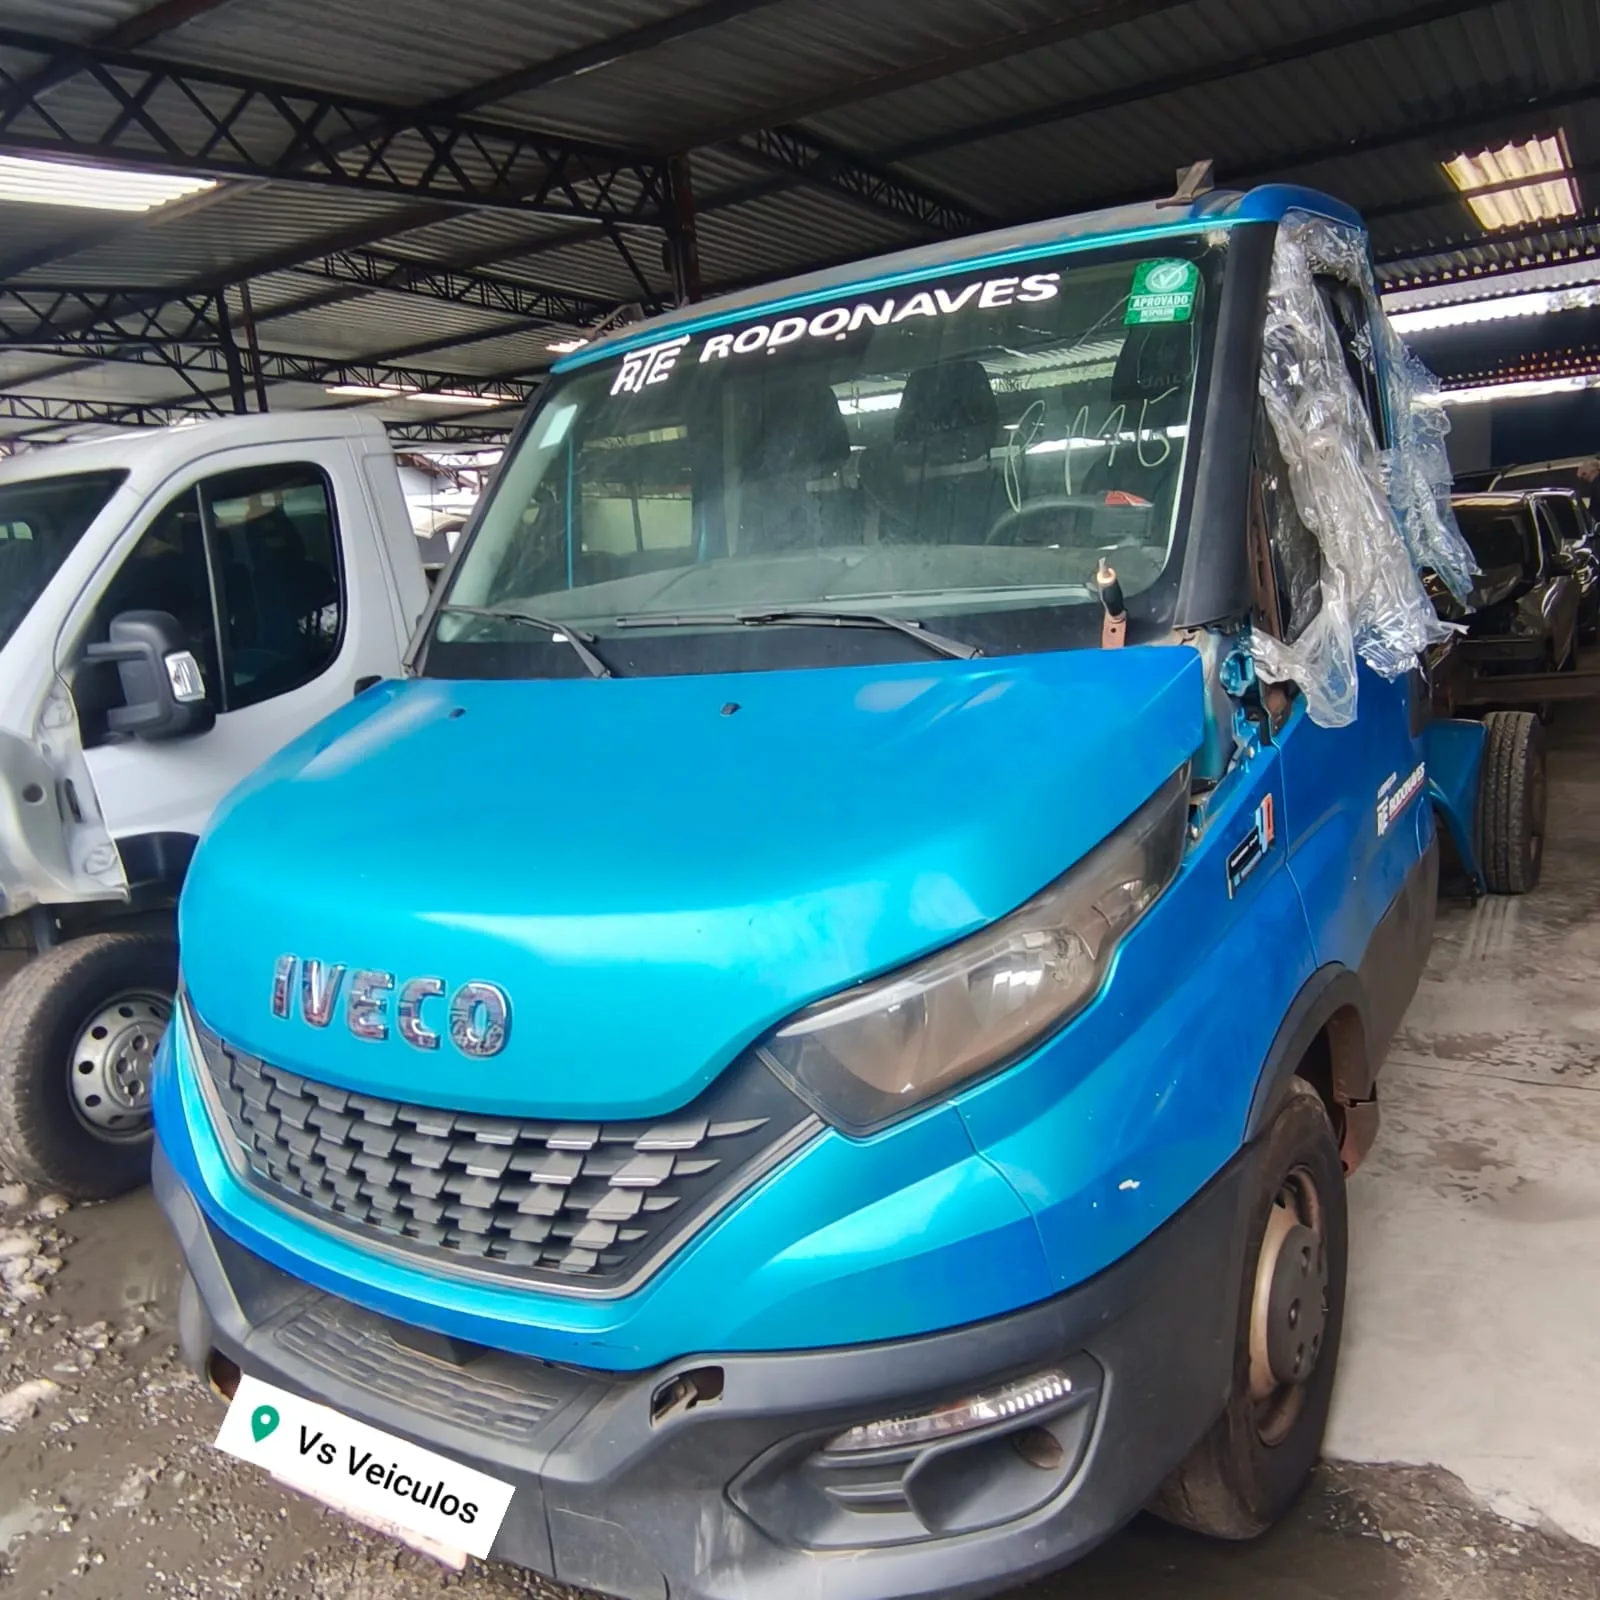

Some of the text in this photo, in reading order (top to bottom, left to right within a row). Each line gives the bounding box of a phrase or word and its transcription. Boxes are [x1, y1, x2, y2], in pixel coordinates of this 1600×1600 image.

[699, 273, 1060, 363] RODONAVES
[1132, 295, 1189, 308] APROVADO
[273, 954, 512, 1058] IVECO
